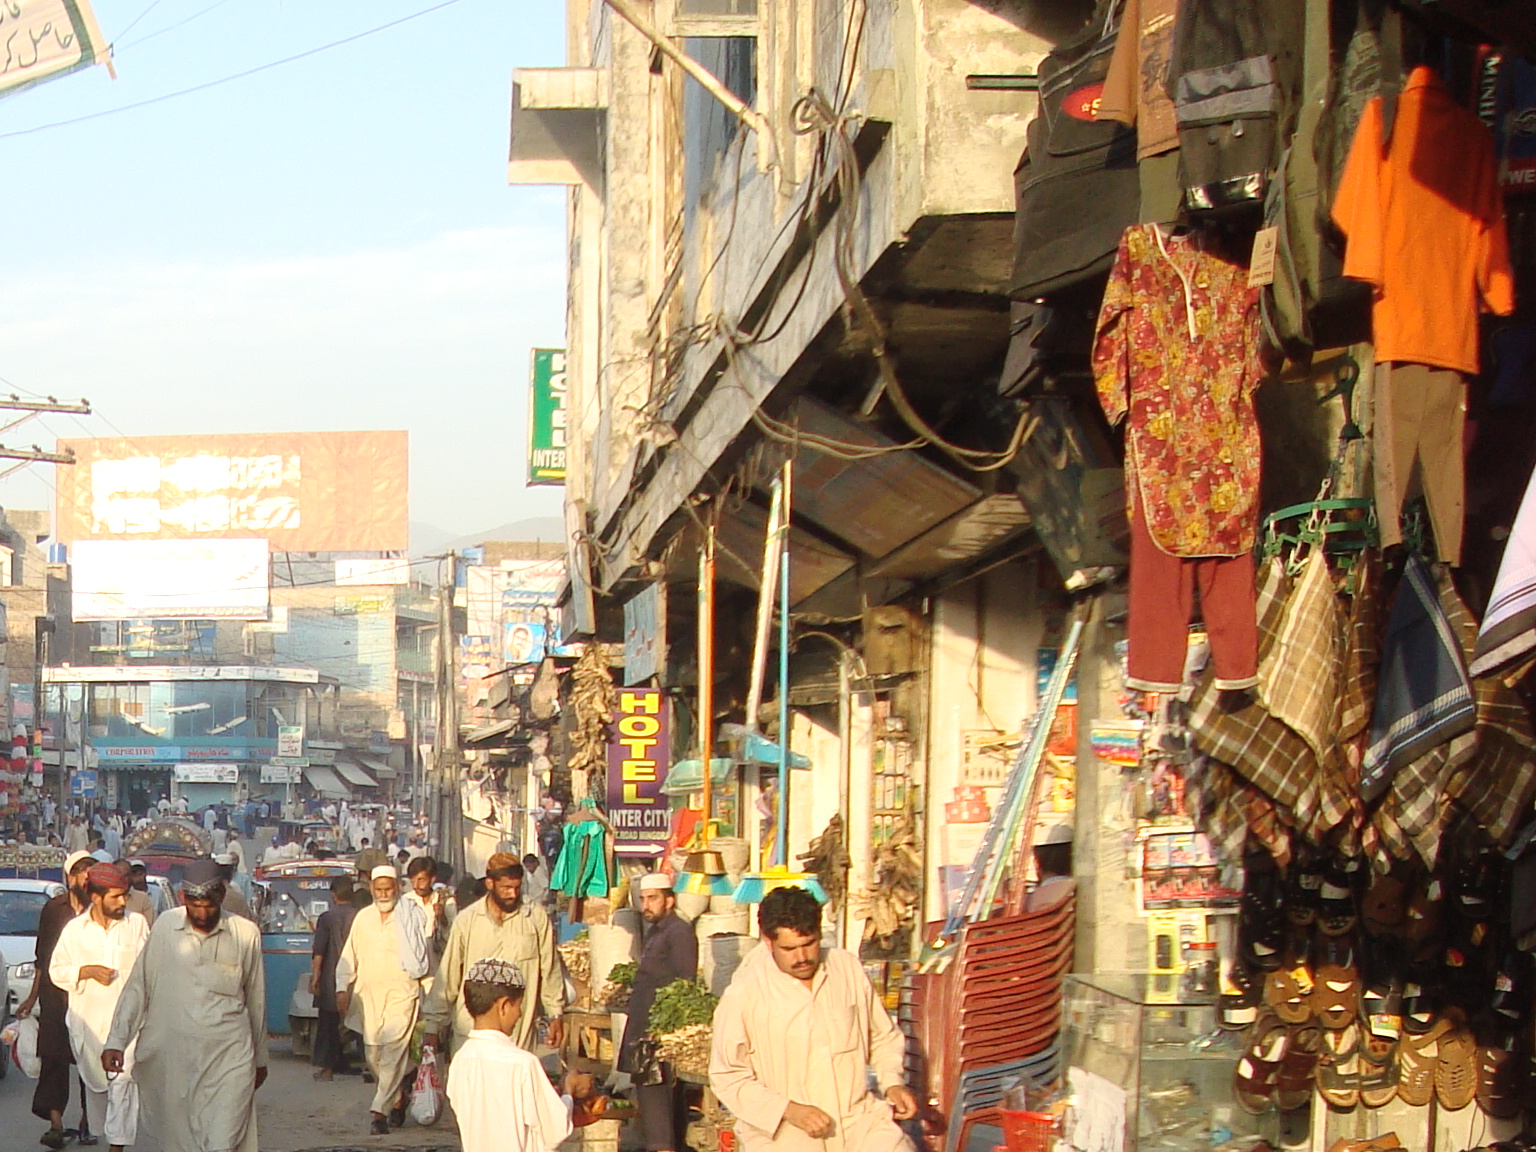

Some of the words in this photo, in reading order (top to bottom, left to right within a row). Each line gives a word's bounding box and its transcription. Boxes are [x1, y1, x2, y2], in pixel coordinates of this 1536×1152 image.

[618, 693, 661, 804] HOTEL
[609, 808, 643, 828] INTER
[644, 808, 671, 828] CITY
